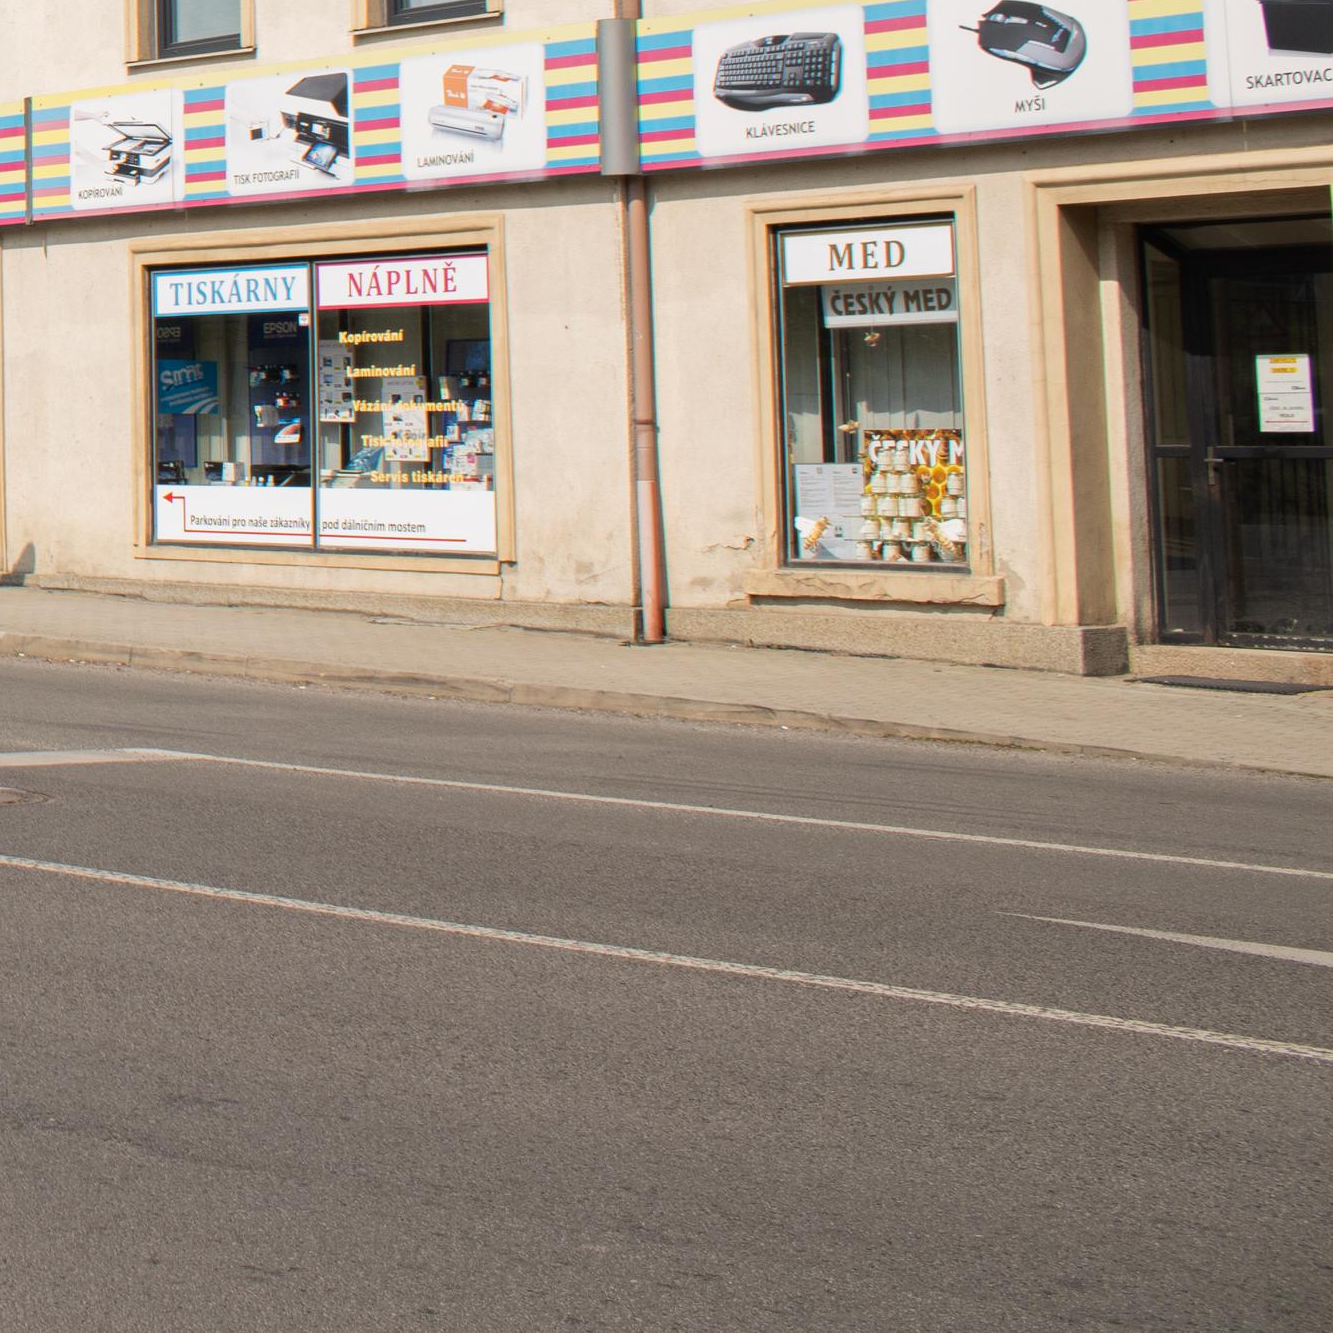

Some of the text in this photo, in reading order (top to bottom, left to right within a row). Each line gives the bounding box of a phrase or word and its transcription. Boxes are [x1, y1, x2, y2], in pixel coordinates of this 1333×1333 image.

[1015, 96, 1045, 113] MYŠI
[746, 121, 815, 139] KLÁVESNICE
[417, 150, 474, 167] LAMINOVÁNÍ
[234, 174, 249, 186] TISK
[828, 240, 906, 271] MED
[347, 261, 457, 298] NÁPLNĚ
[169, 273, 296, 306] TISKÁRNY
[830, 285, 952, 316] ČESKÝ MED
[263, 321, 297, 334] EPSON
[338, 329, 404, 345] Kopírování
[346, 364, 416, 378] Laminování
[370, 470, 464, 484] Servis tiskáren
[190, 515, 310, 531] Parkování pro naše zákazníky
[322, 518, 426, 533] pod dálničním mostem
